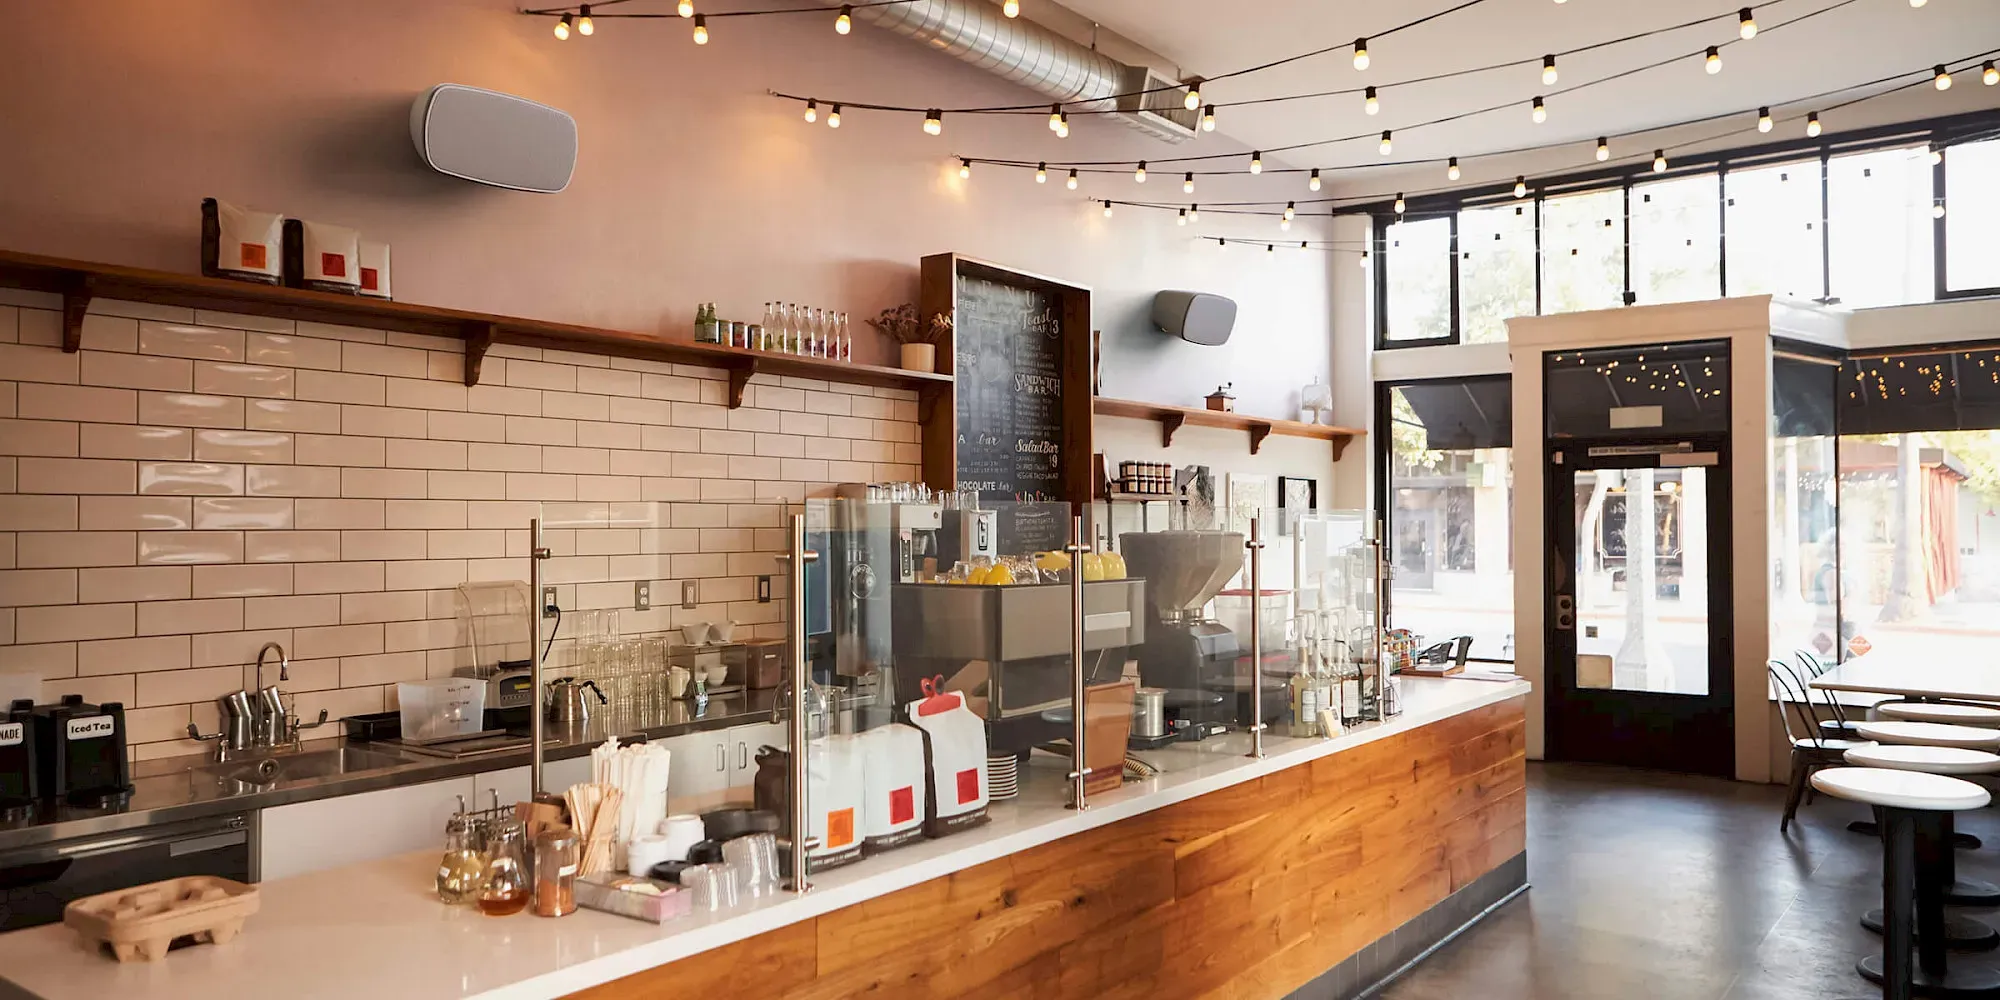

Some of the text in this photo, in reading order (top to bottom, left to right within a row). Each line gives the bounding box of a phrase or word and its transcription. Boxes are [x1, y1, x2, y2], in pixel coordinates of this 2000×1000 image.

[1018, 308, 1050, 330] Toast
[1014, 374, 1061, 397] SANDWICH
[1028, 386, 1048, 395] BAR
[1015, 439, 1059, 454] Salad Bar
[71, 722, 111, 733] Iced Tea
